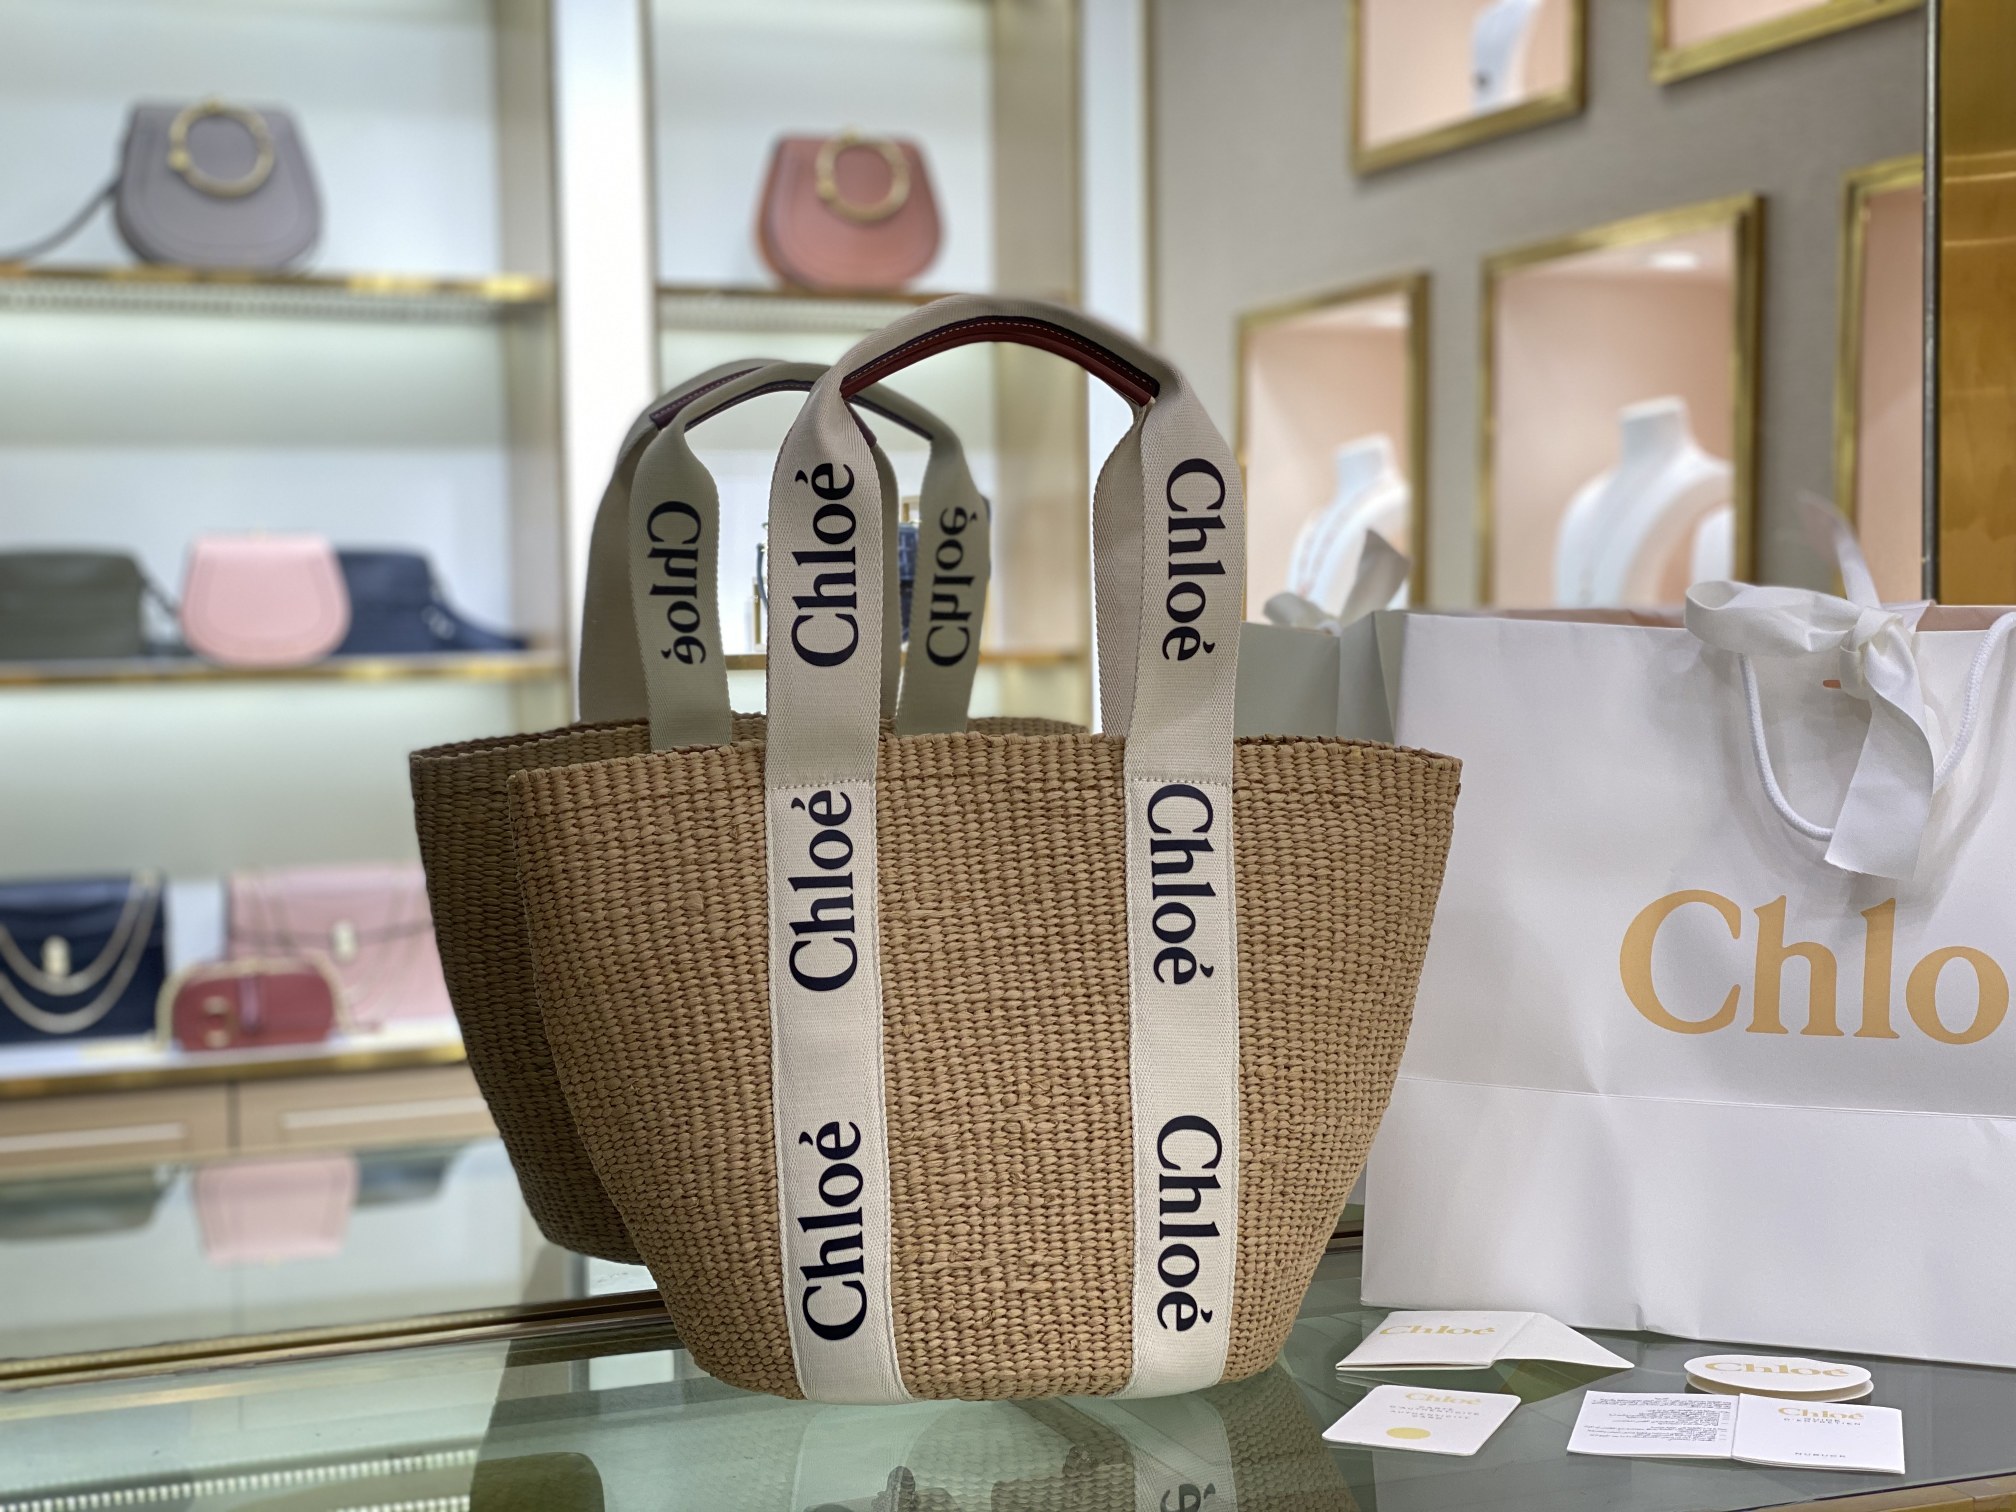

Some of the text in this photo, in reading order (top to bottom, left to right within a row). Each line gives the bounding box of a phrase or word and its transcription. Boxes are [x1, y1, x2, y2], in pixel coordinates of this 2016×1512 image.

[790, 461, 860, 668] Chloé
[1161, 457, 1227, 662] Chloé
[788, 789, 858, 992] Chloé
[1147, 783, 1217, 985] Chloé
[1619, 889, 2010, 1045] Chlo
[798, 1120, 868, 1342] Chloé
[1156, 1114, 1223, 1332] Chloé
[1378, 1325, 1496, 1336] Chloé
[1704, 1361, 1849, 1377] Chloé
